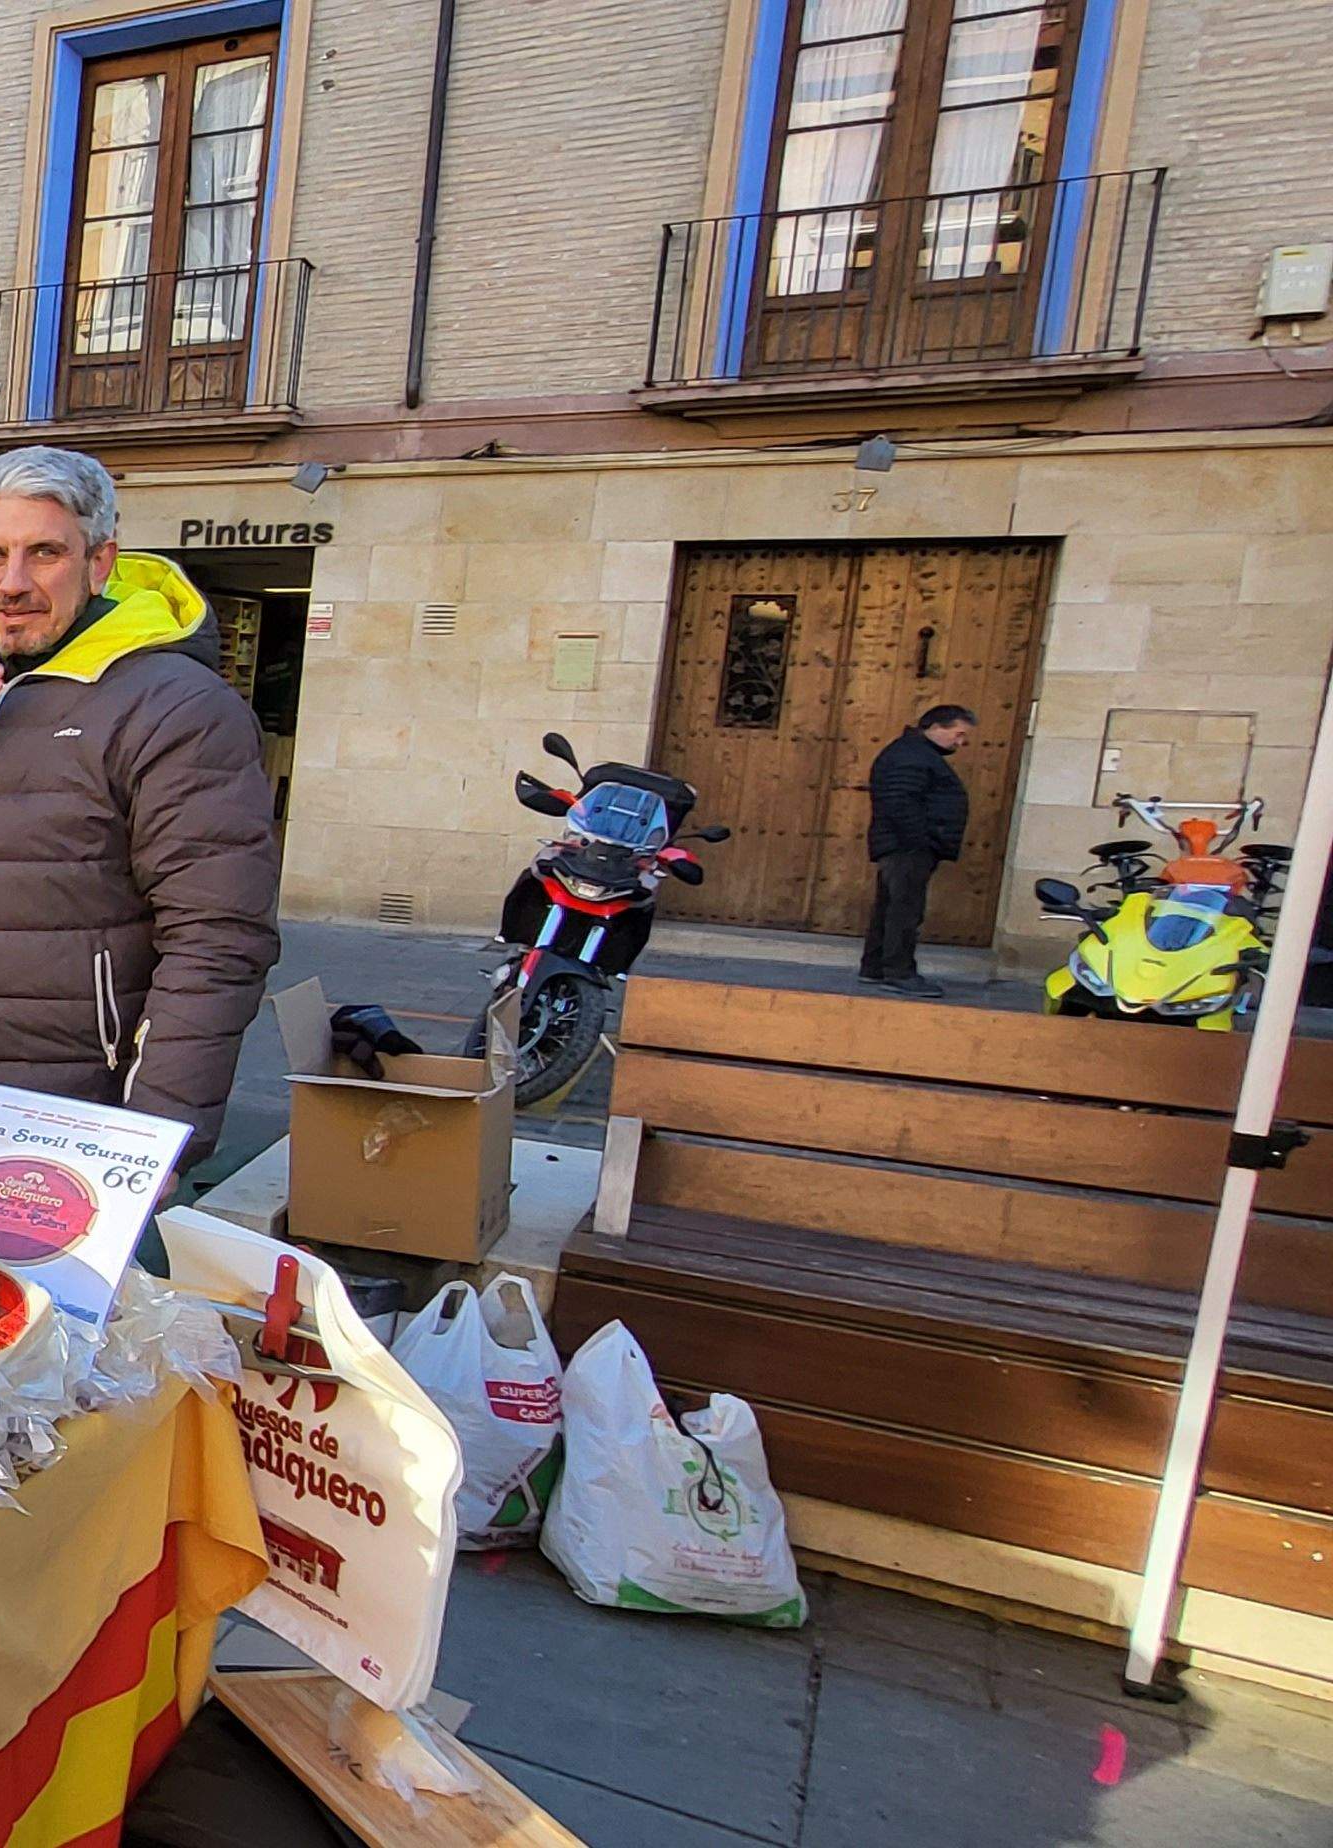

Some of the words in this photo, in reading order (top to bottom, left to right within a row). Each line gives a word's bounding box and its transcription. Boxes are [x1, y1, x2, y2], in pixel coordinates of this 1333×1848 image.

[832, 487, 878, 512] 37
[179, 518, 334, 547] Pinturas
[12, 1128, 69, 1149] Sevil
[75, 1141, 160, 1170] Curado
[102, 1165, 154, 1195] 6€
[309, 1422, 339, 1460] de
